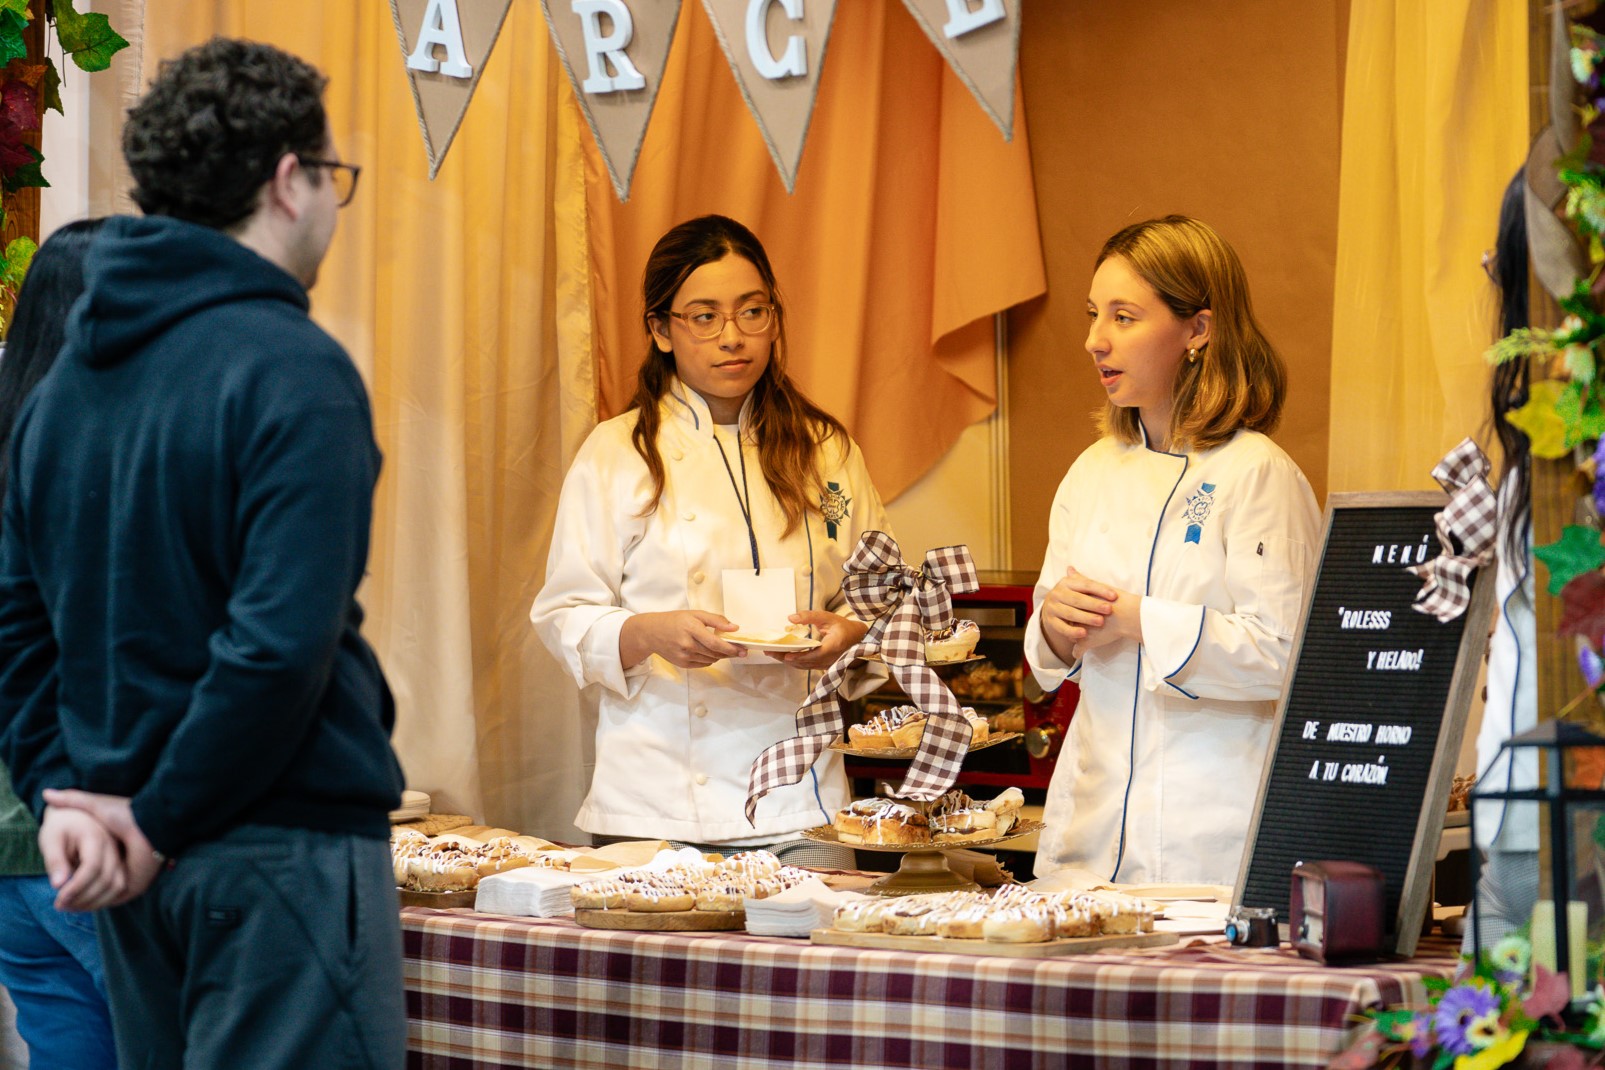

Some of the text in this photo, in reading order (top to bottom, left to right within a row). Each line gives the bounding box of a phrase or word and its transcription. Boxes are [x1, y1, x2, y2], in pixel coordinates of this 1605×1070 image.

[1366, 648, 1424, 671] Y HELADO!
[1302, 720, 1412, 745] DE NUESTRO HORNO
[1308, 754, 1389, 785] A TU CORAZÓN
